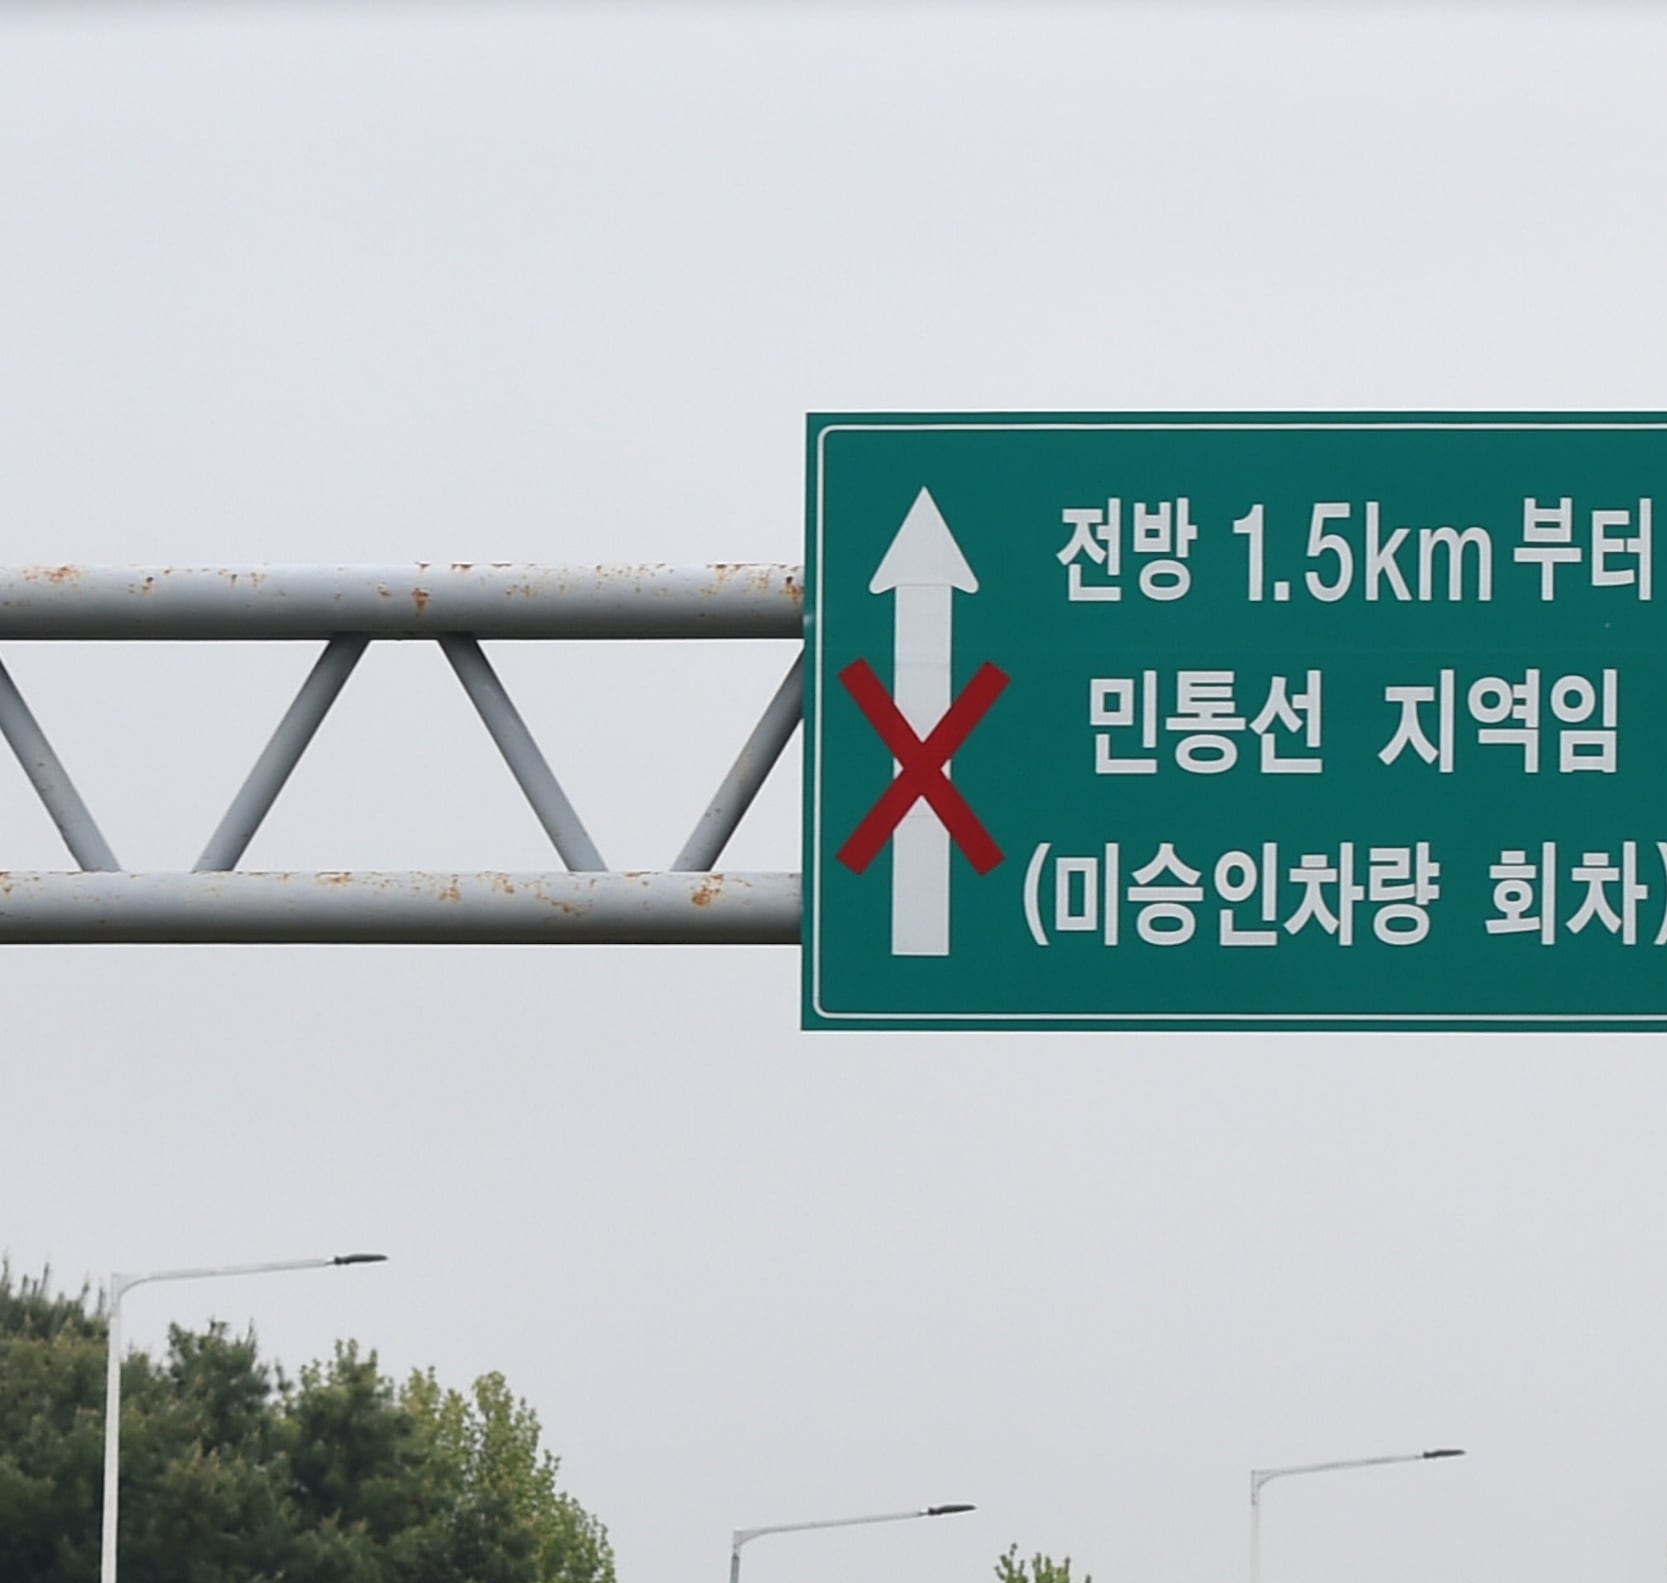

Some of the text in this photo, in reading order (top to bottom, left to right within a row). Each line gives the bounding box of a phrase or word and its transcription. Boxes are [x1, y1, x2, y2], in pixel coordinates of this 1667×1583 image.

[1057, 498, 1197, 601] 전방
[1090, 669, 1618, 774] 민통선 지역임
[1024, 842, 1440, 946] (미승인차량
